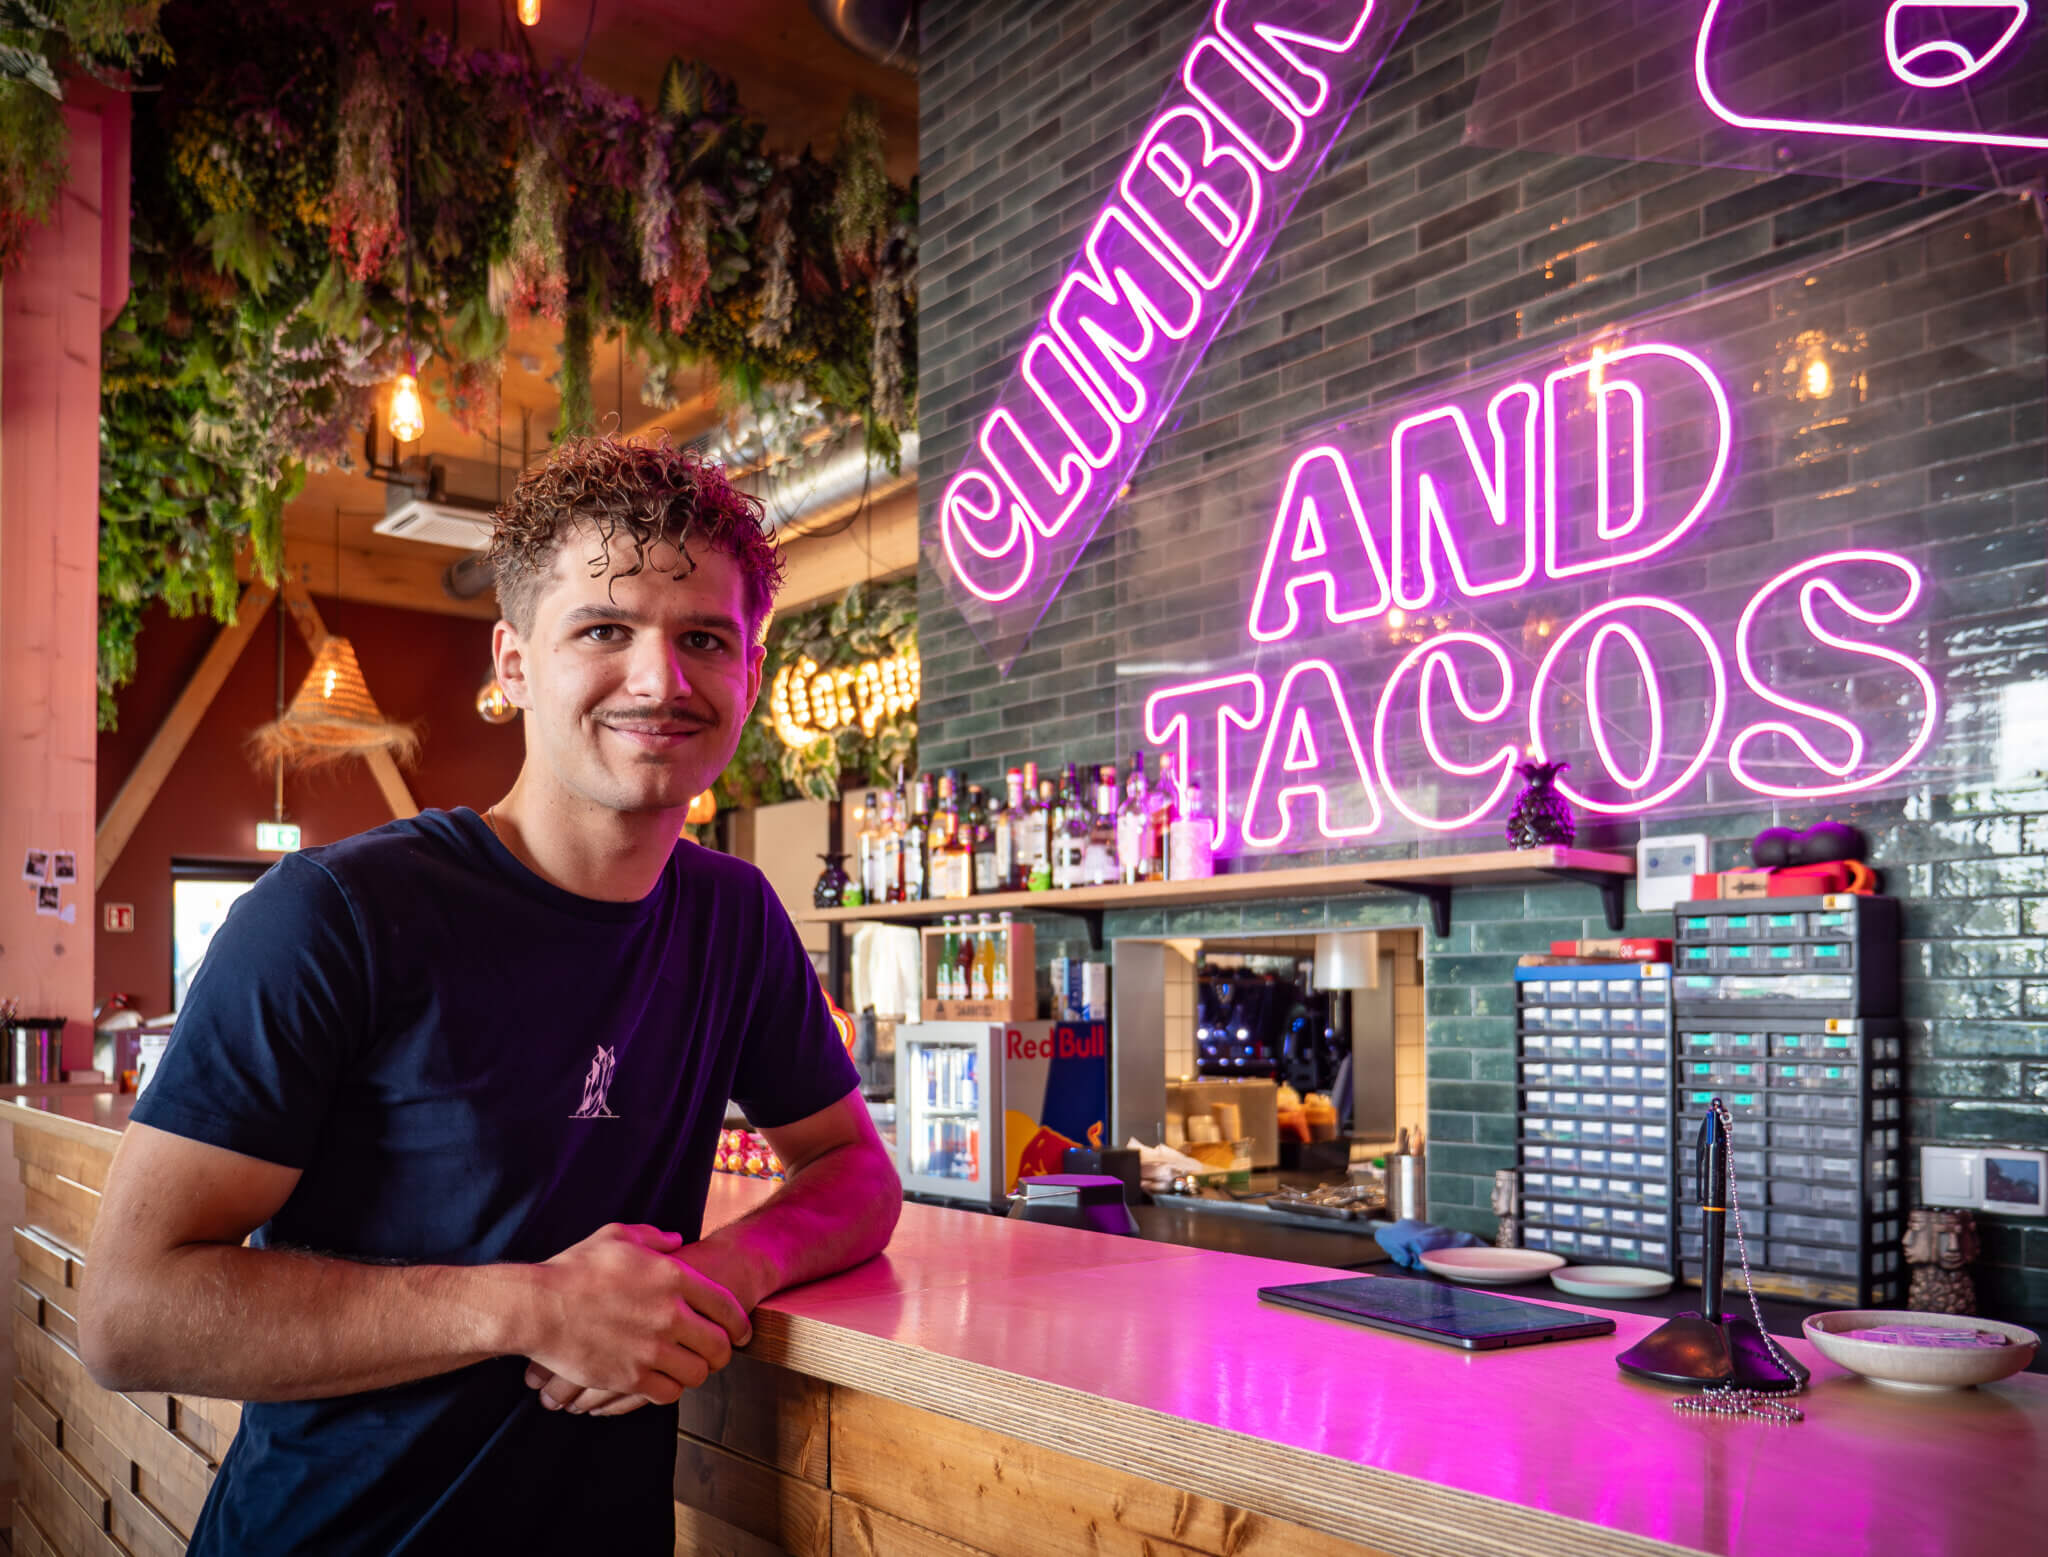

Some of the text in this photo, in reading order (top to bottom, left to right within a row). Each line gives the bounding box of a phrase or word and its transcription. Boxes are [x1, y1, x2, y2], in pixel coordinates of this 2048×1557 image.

[1247, 343, 1732, 644] AND
[1144, 548, 1940, 849] TACOS
[1007, 1024, 1105, 1060] Red Bull
